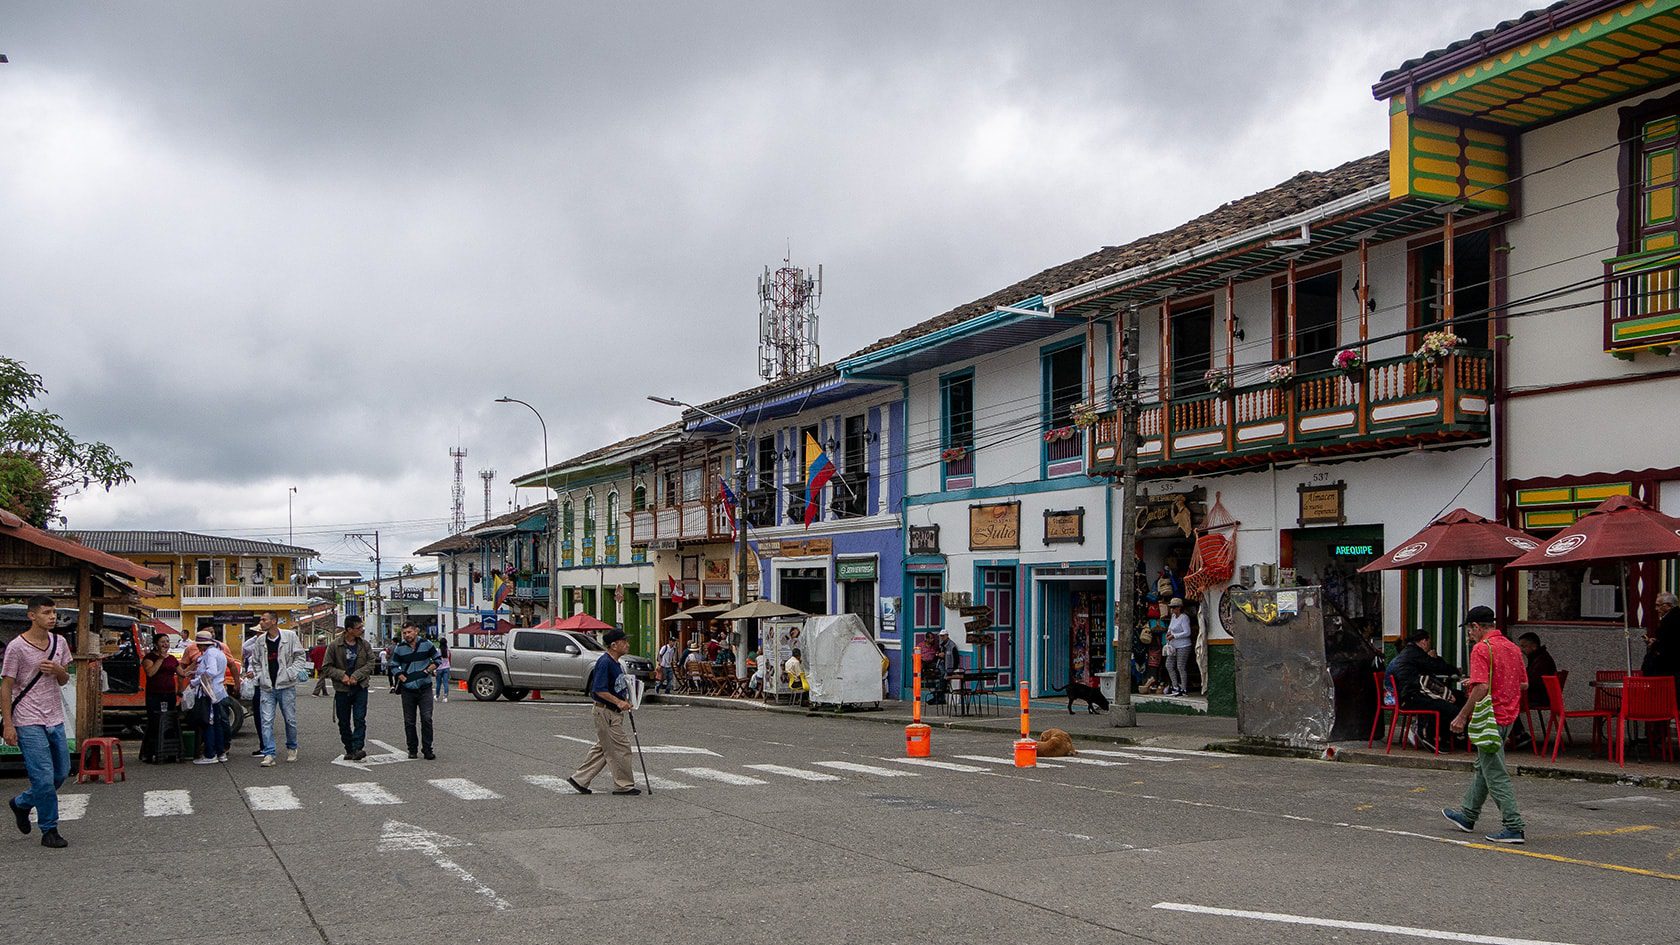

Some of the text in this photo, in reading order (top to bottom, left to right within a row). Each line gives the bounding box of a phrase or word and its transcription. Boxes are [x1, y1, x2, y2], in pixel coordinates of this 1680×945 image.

[1313, 472, 1329, 481] 537
[972, 524, 1017, 546] Julio
[1335, 545, 1373, 555] AREQUIPE
